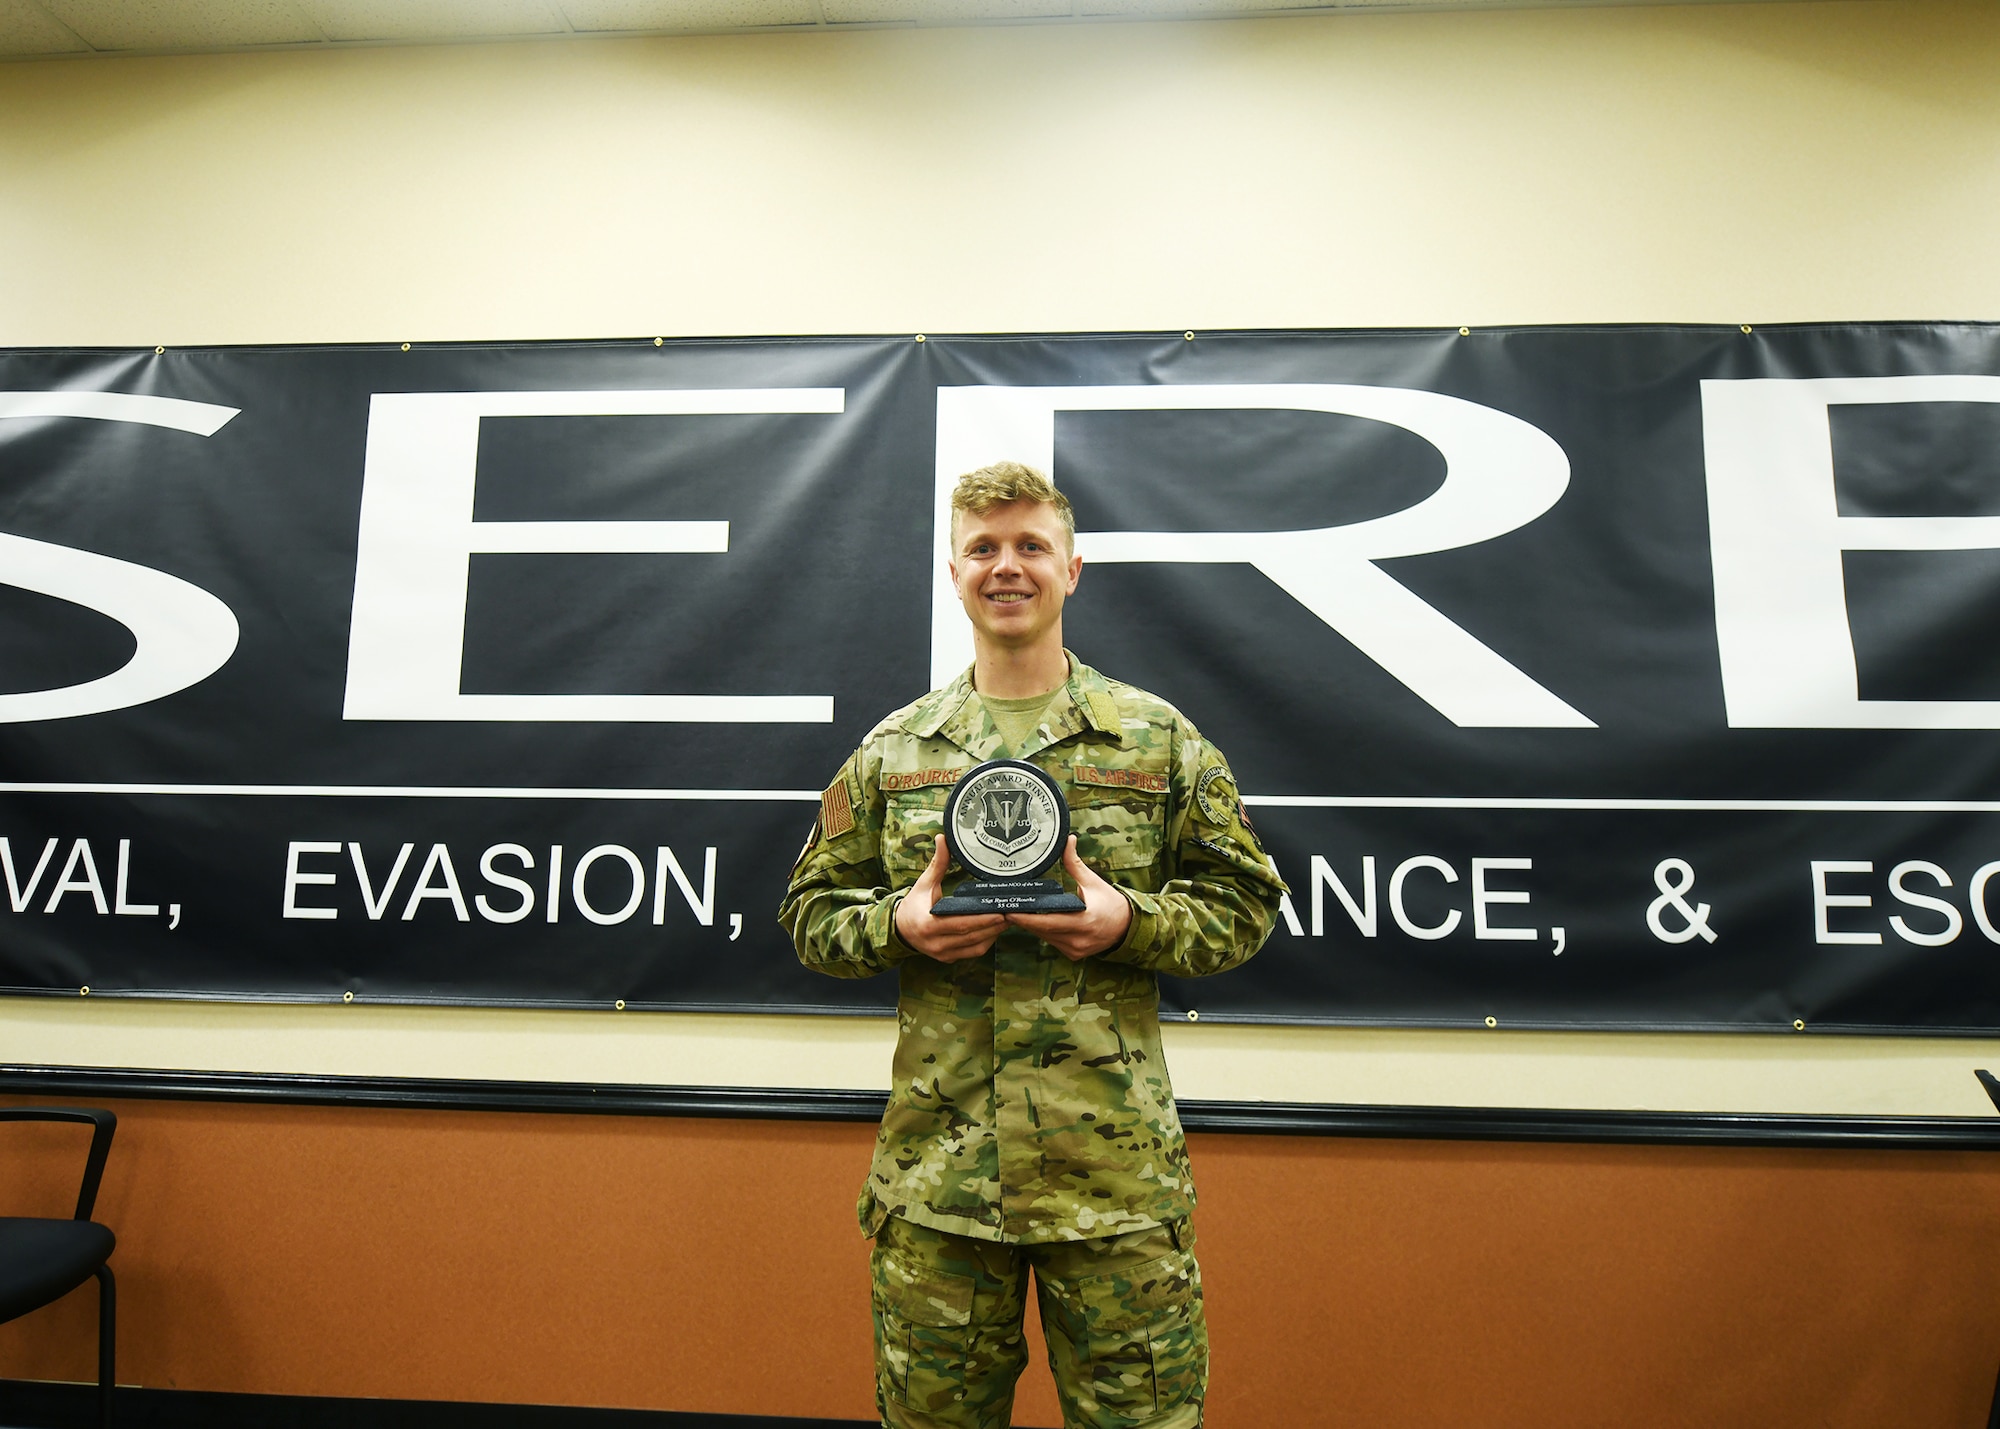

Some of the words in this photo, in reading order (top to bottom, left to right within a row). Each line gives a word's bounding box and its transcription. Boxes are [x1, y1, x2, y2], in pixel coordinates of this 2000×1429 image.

[887, 768, 962, 789] O'ROURKE
[1077, 767, 1102, 784] U.S.
[1105, 769, 1126, 786] AIR
[1129, 770, 1166, 791] FORCE
[960, 782, 986, 817] ANNUAL
[987, 774, 1022, 786] AWARD
[1025, 780, 1052, 815] WINNER
[978, 830, 989, 842] AIR
[1012, 828, 1037, 848] COMMAND
[998, 860, 1017, 868] 2021
[281, 840, 744, 941] EVASION,
[1645, 857, 1719, 945] &
